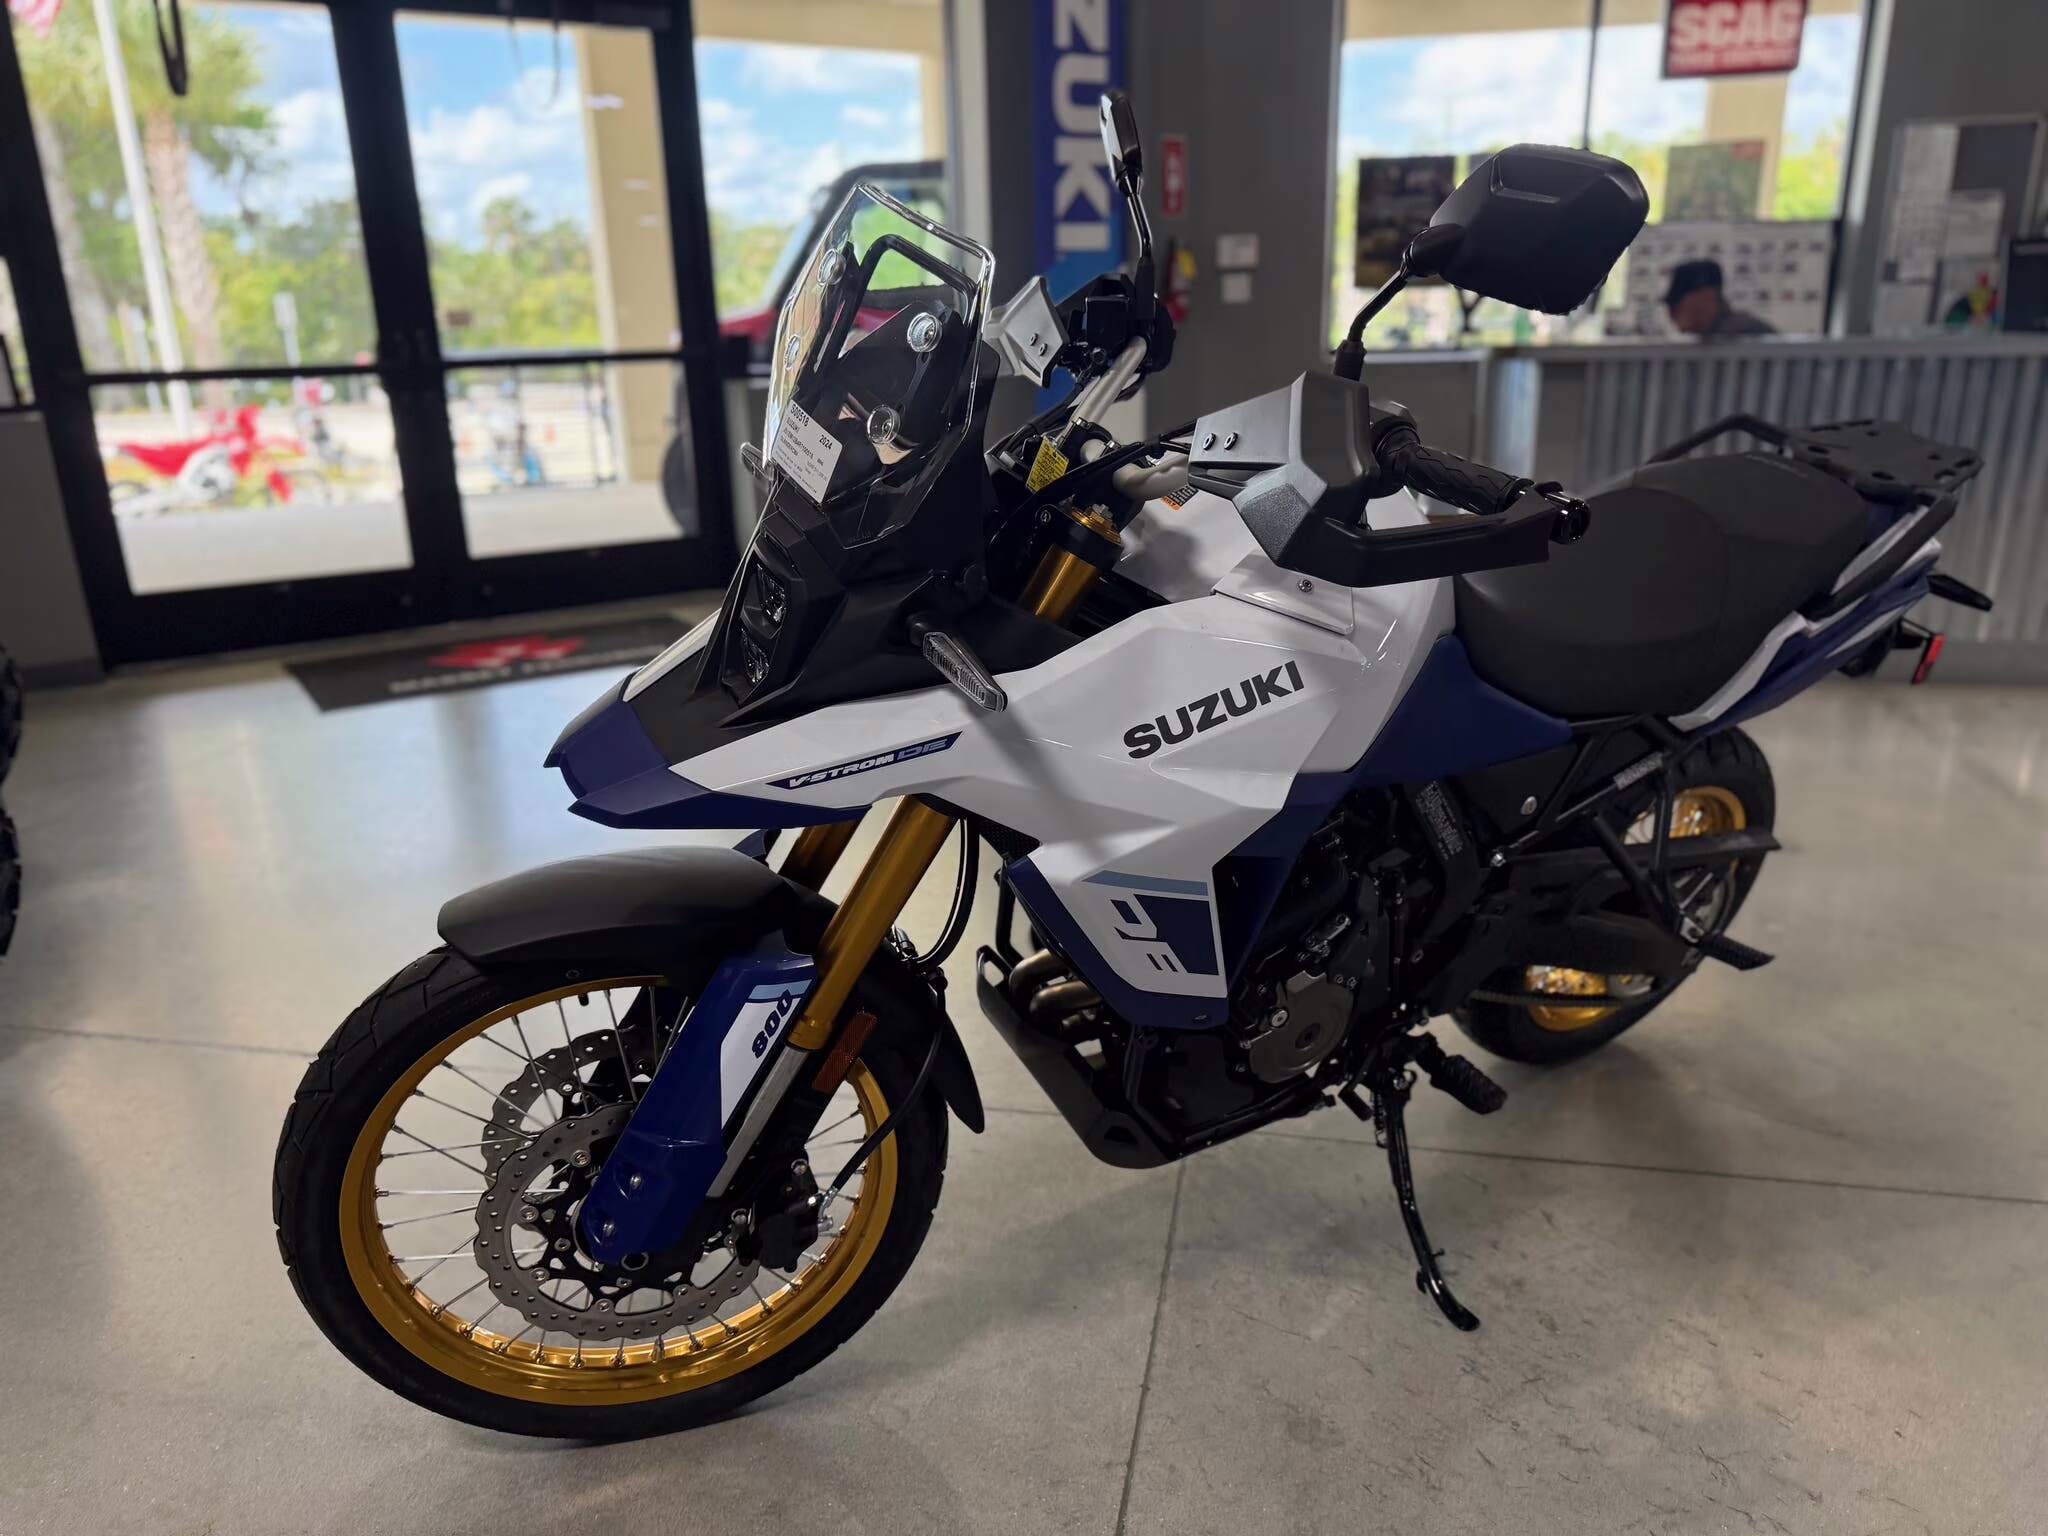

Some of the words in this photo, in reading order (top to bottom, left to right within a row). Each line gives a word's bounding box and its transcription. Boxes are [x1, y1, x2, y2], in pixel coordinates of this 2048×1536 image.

[1671, 1, 1800, 47] SCAG
[819, 434, 833, 450] 2024
[1123, 660, 1305, 759] SUZUKI
[752, 989, 794, 1059] 800
